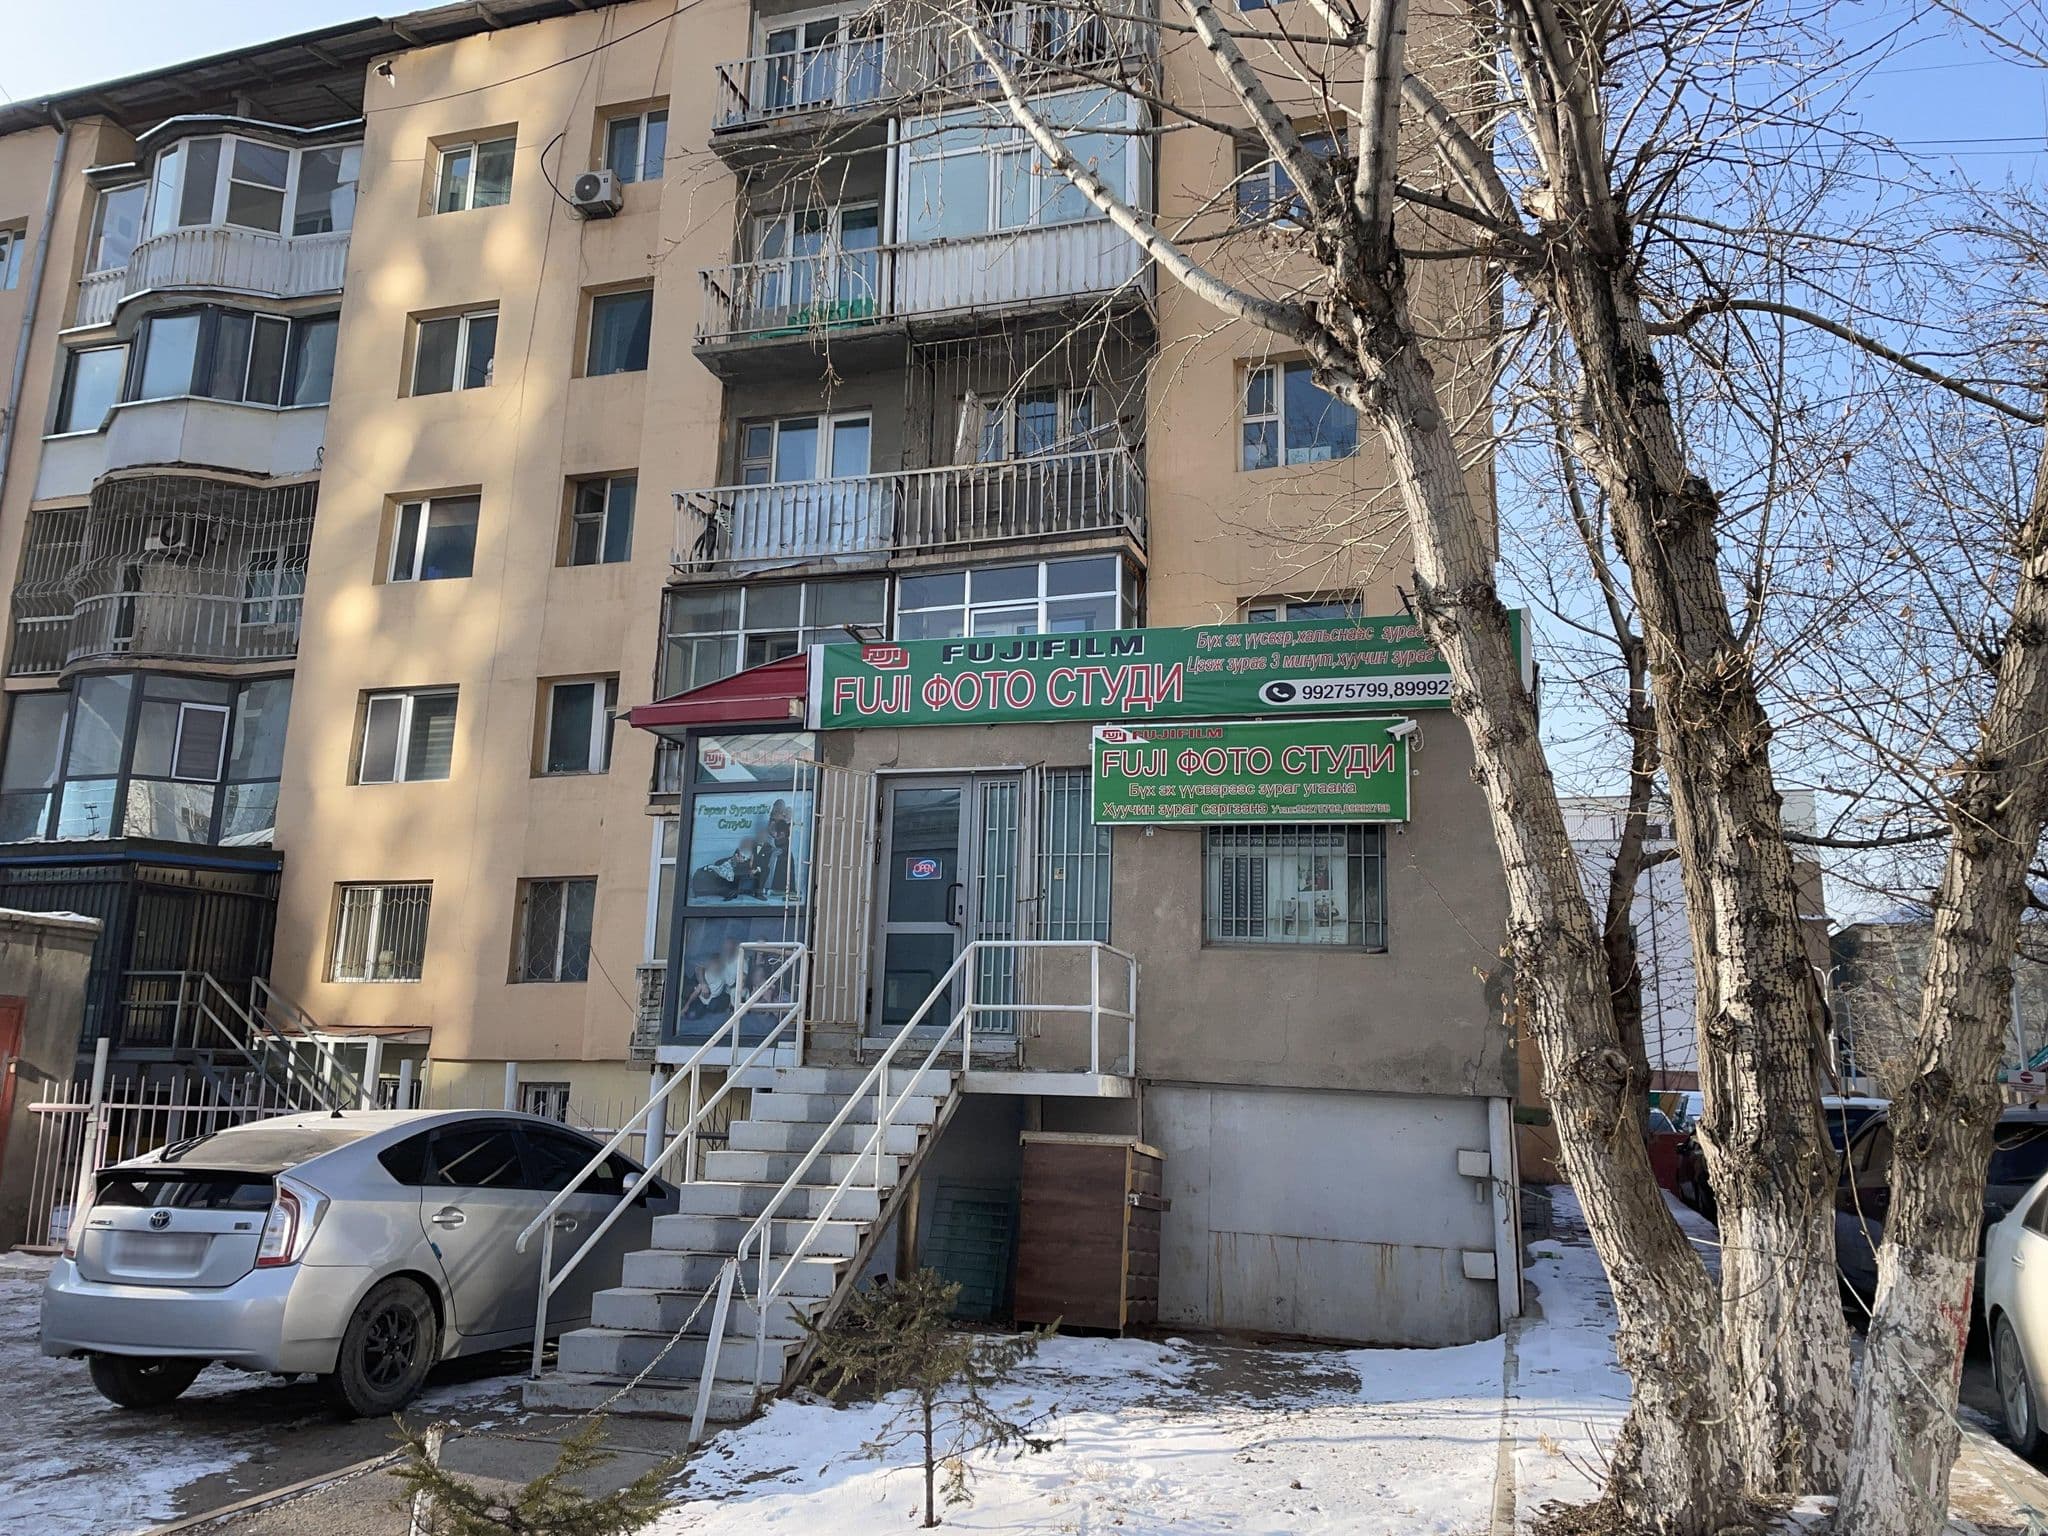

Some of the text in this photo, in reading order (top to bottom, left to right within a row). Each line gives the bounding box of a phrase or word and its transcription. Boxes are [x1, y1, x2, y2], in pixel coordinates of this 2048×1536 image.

[942, 635, 1145, 665] FUJIFILM
[1196, 631, 1223, 652] Бүх
[1225, 633, 1242, 647] эх
[1270, 651, 1281, 670] 3
[832, 661, 1184, 716] FUJI ФОТО СТУДИ
[1302, 679, 1453, 700] 99275799,89992
[1132, 728, 1224, 740] FUJIFILM
[1101, 743, 1395, 779] FUJI ФОТО СТУДИ
[1128, 782, 1357, 800] Бүх эх үүсвэрээс зураг угаана
[1102, 801, 1155, 819] Хуучин
[1157, 802, 1198, 818] зураг
[1201, 802, 1269, 817] сэргээнэ
[913, 863, 934, 873] OPEN
